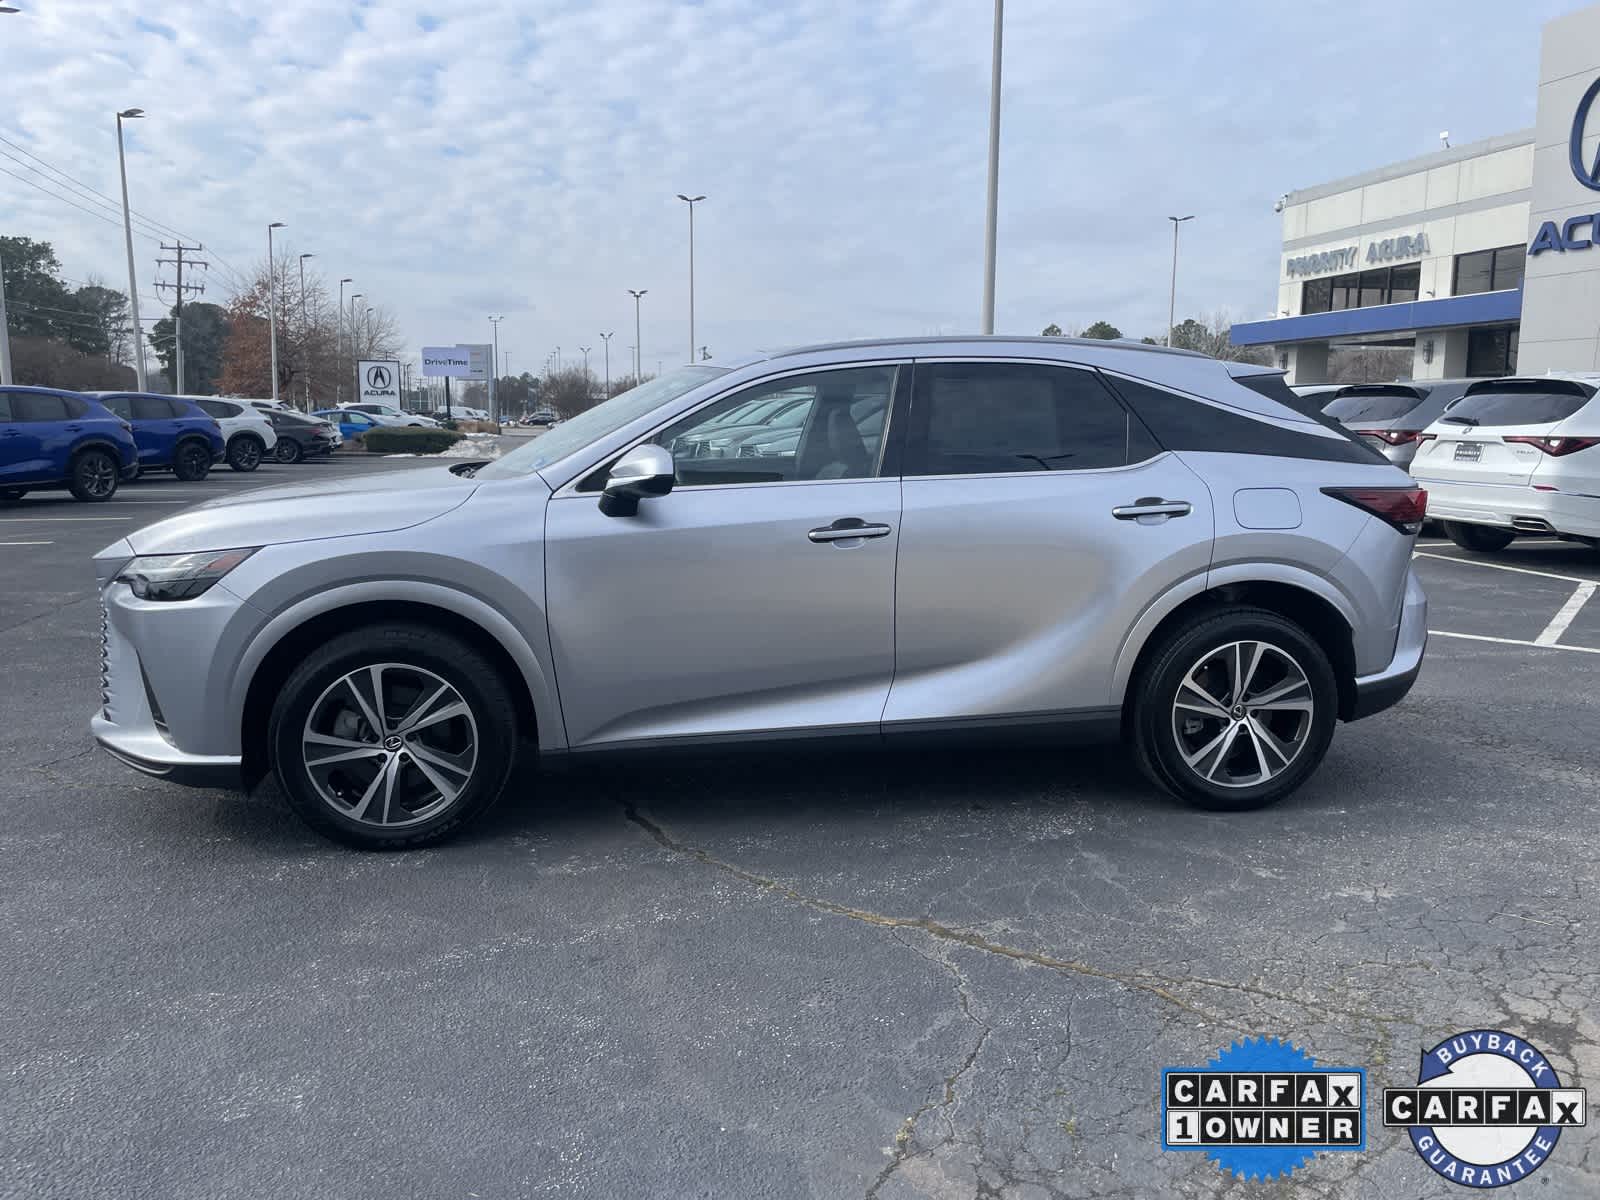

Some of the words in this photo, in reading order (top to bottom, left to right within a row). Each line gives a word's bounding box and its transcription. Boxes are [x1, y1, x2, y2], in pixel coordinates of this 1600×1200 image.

[1286, 246, 1358, 278] PRIORITY
[1366, 232, 1431, 264] ACURA
[1528, 213, 1600, 255] AC
[424, 358, 468, 367] DriveTime
